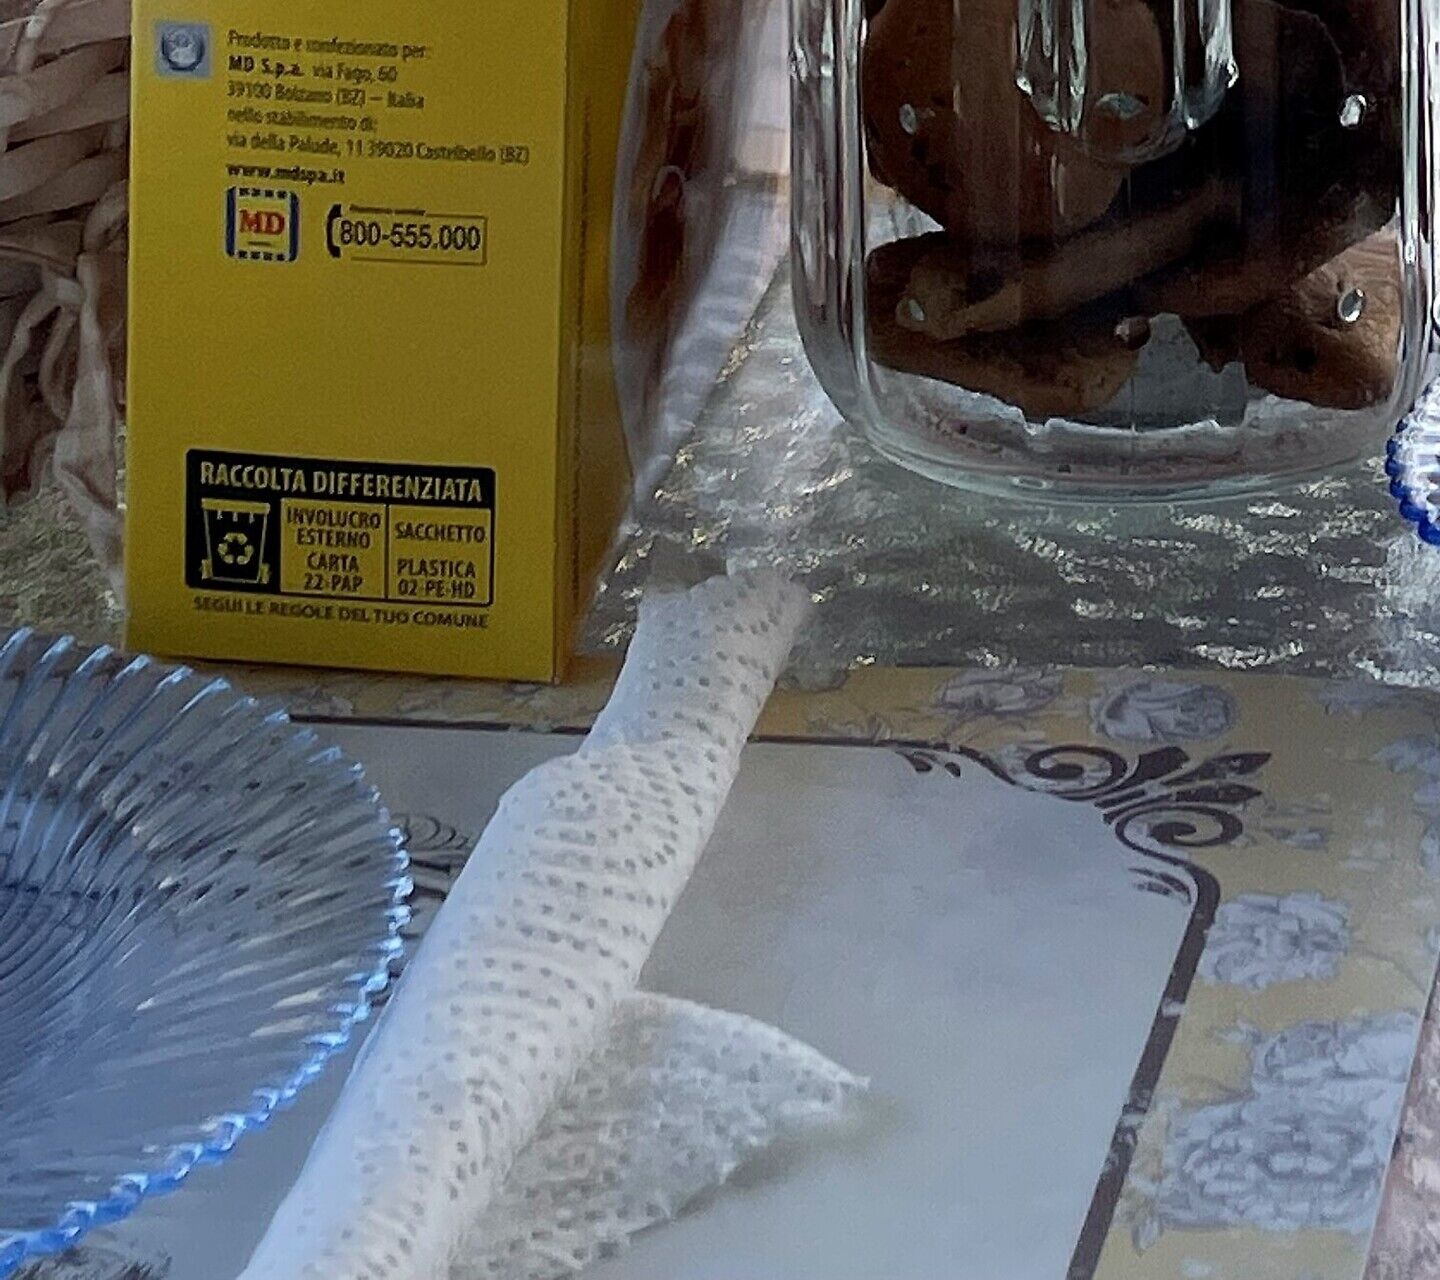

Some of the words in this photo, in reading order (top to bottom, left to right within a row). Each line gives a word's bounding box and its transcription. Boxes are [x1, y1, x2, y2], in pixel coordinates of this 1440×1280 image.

[228, 55, 254, 72] MD
[225, 163, 344, 184] www.mdspa.it
[239, 209, 285, 235] MD
[340, 219, 481, 250] 800-555.000
[200, 460, 306, 492] RACCOLTA
[312, 470, 482, 503] DIFFERENZIATA
[287, 506, 381, 530] INVOLUCRO
[297, 527, 370, 550] ESTERNO
[395, 520, 486, 544] SACCHETTO
[307, 551, 359, 573] CARTA
[397, 556, 475, 579] PLASTICA
[193, 596, 242, 613] SEGUI
[245, 600, 263, 615] LE
[269, 601, 334, 619] REGOLE
[338, 606, 370, 622] DEL
[375, 608, 409, 625] TUO
[413, 610, 489, 630] COMUNE
